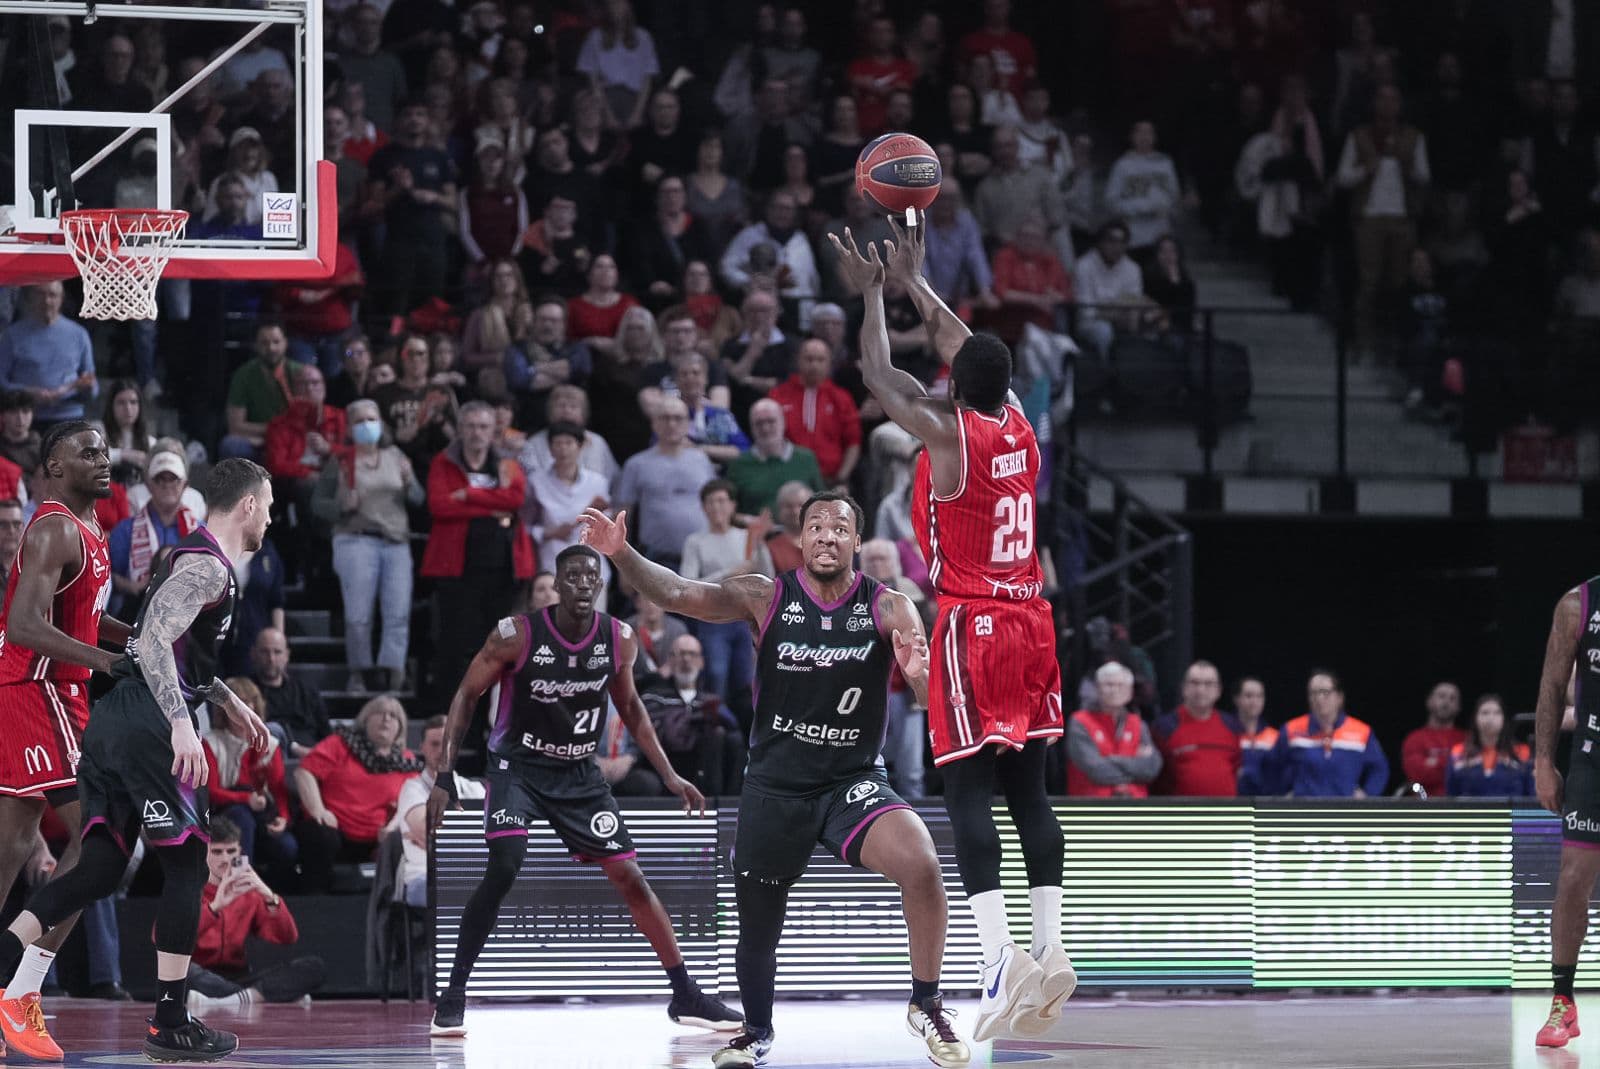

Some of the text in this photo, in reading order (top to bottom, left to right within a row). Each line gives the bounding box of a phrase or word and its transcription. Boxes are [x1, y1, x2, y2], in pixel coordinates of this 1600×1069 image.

[991, 448, 1028, 479] CHERRY
[990, 492, 1033, 562] 29
[781, 613, 805, 625] ayor
[974, 615, 993, 636] 29
[532, 655, 556, 666] ayor
[777, 640, 875, 667] Périgord
[530, 674, 608, 697] Périgord
[836, 687, 862, 715] 0
[573, 707, 601, 734] 21
[522, 732, 597, 756] E.Leclerc
